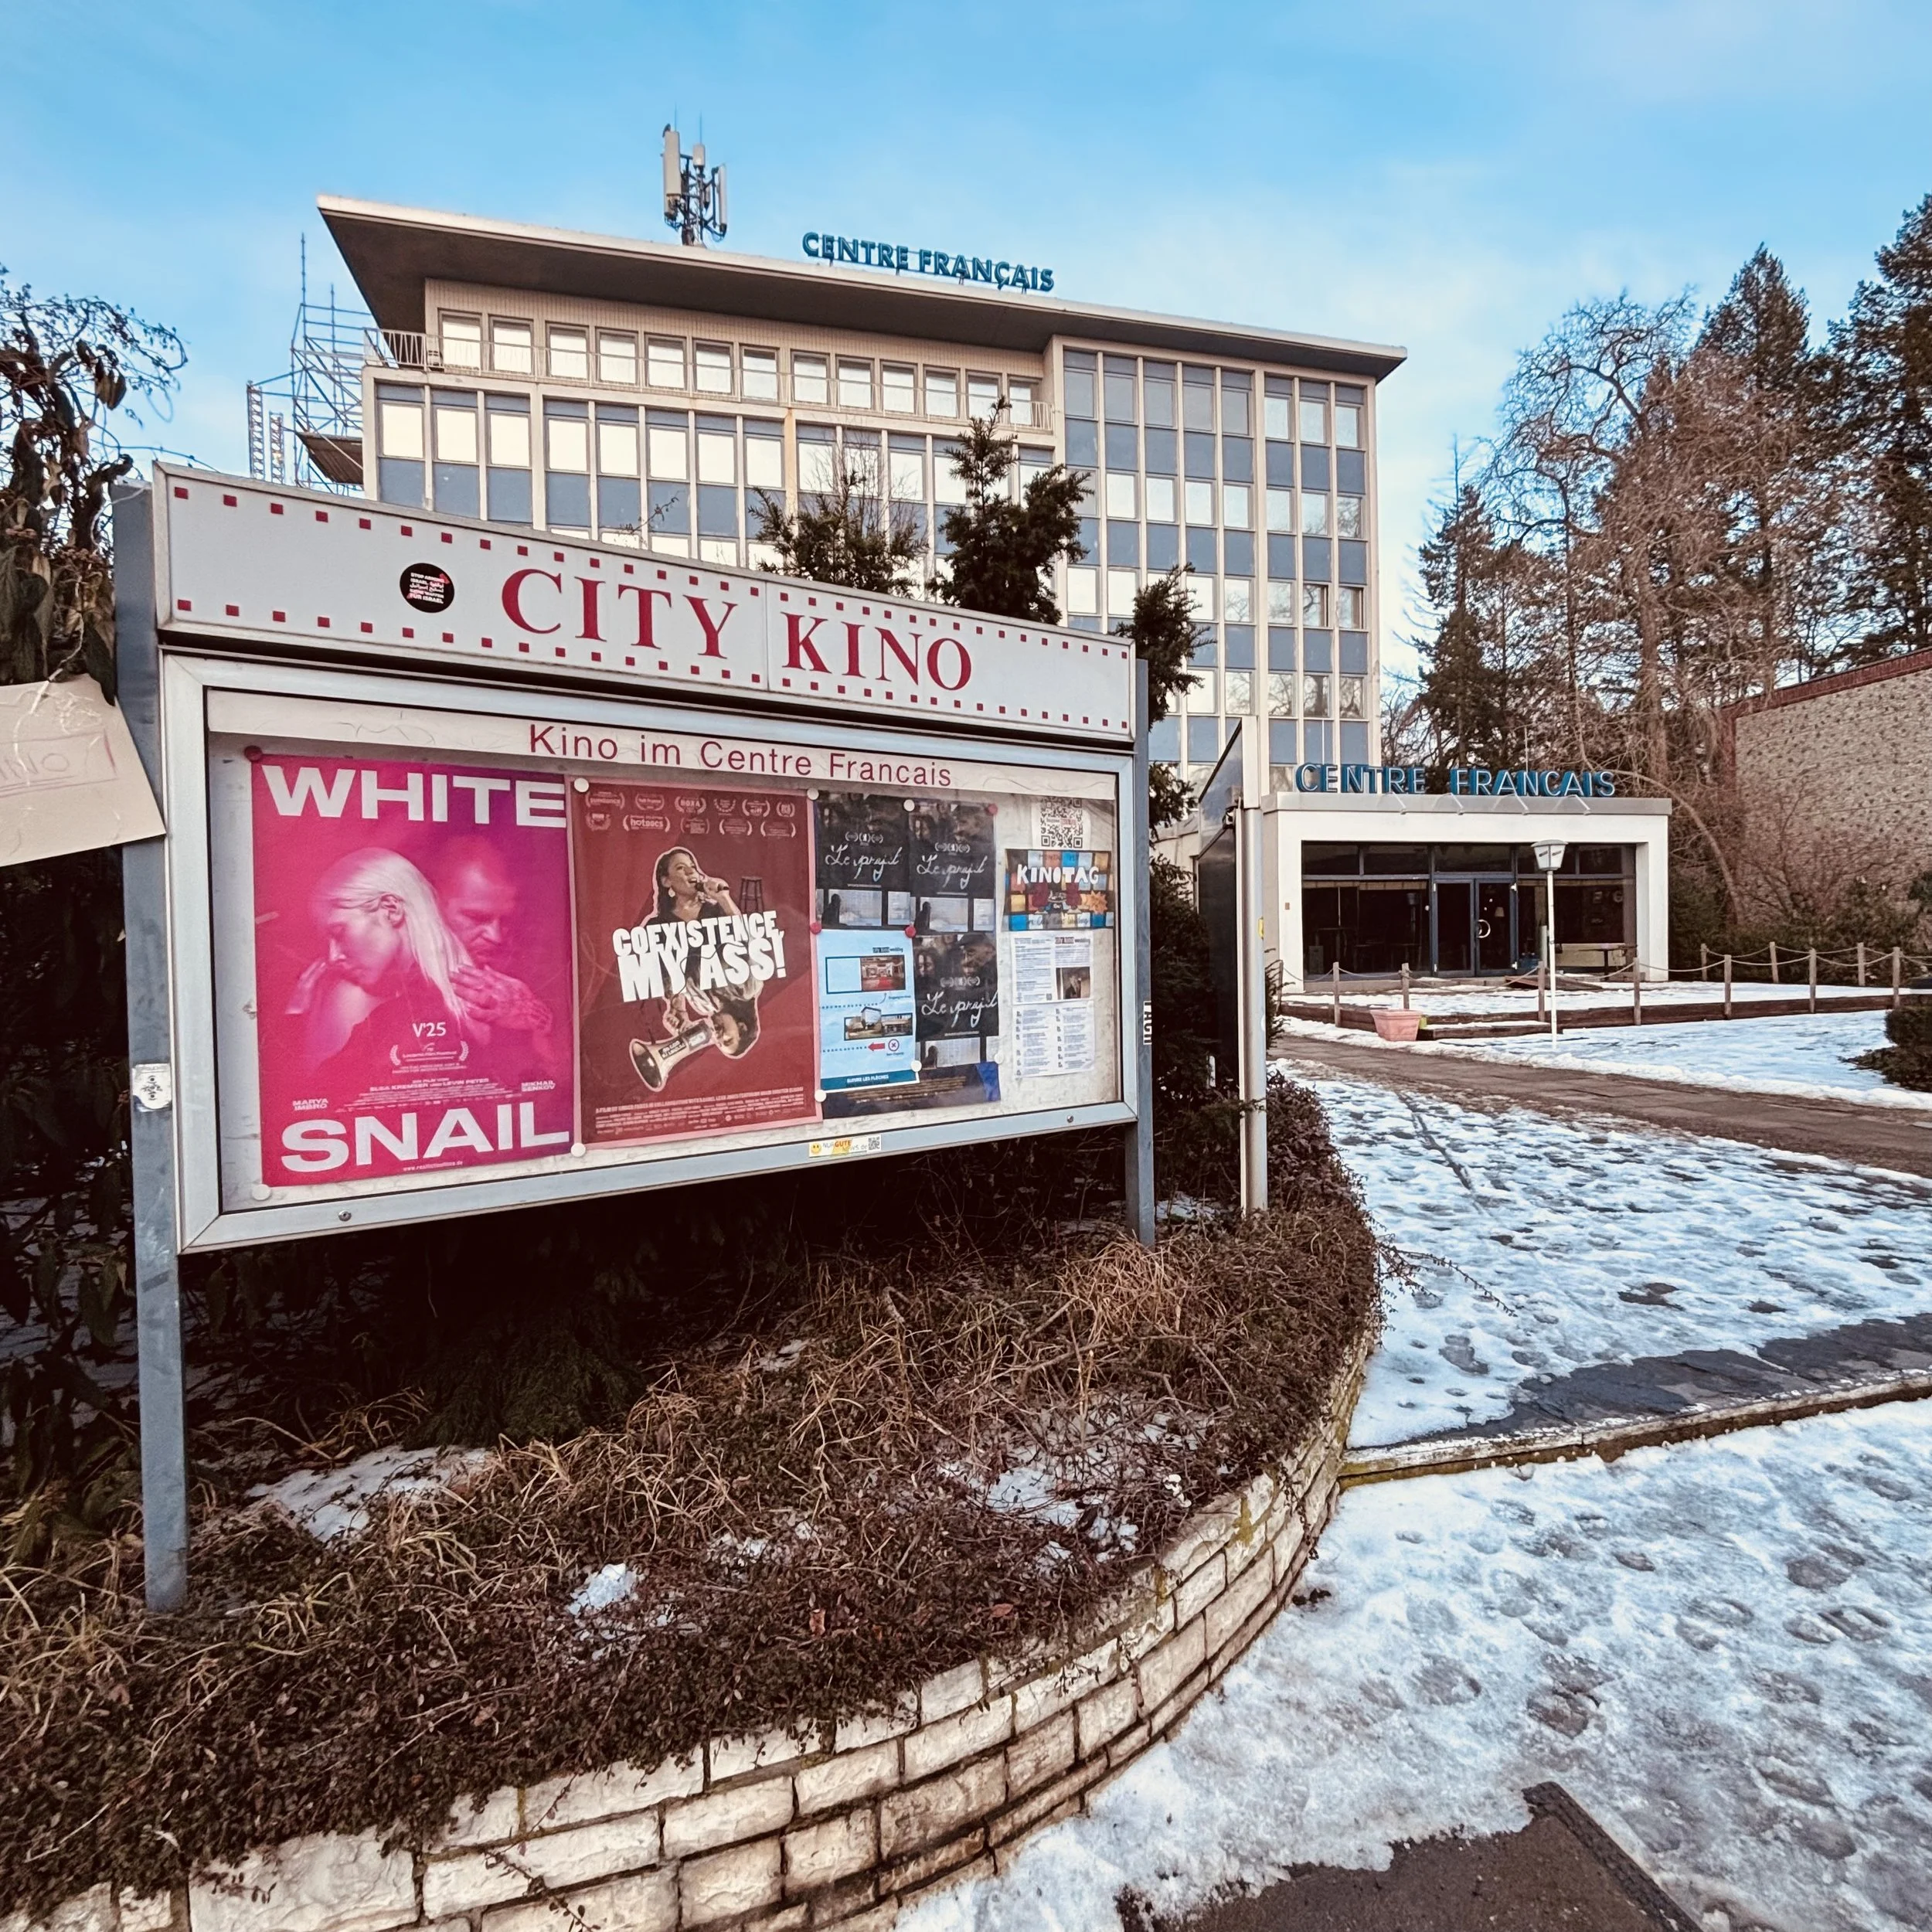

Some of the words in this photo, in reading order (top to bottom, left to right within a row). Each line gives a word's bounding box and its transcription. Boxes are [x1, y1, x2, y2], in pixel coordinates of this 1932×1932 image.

[802, 232, 908, 270] CENTRE
[919, 249, 1055, 291] FRANÇAIS
[502, 569, 738, 659] CITY
[781, 612, 971, 691] KINO
[530, 724, 617, 759] Kino
[641, 734, 681, 765] im
[700, 741, 811, 776] Centre
[830, 753, 951, 787] Francais
[1295, 764, 1427, 794] CENTRE
[1450, 769, 1615, 797] FRANCAIS
[262, 765, 566, 828] WHITE
[1016, 863, 1100, 886] KINOTAG
[612, 910, 778, 957] COEXISTENCE
[618, 944, 689, 1002] MY
[699, 929, 785, 990] ASS!
[413, 1022, 447, 1037] V'25
[281, 1101, 570, 1173] SNAIL
